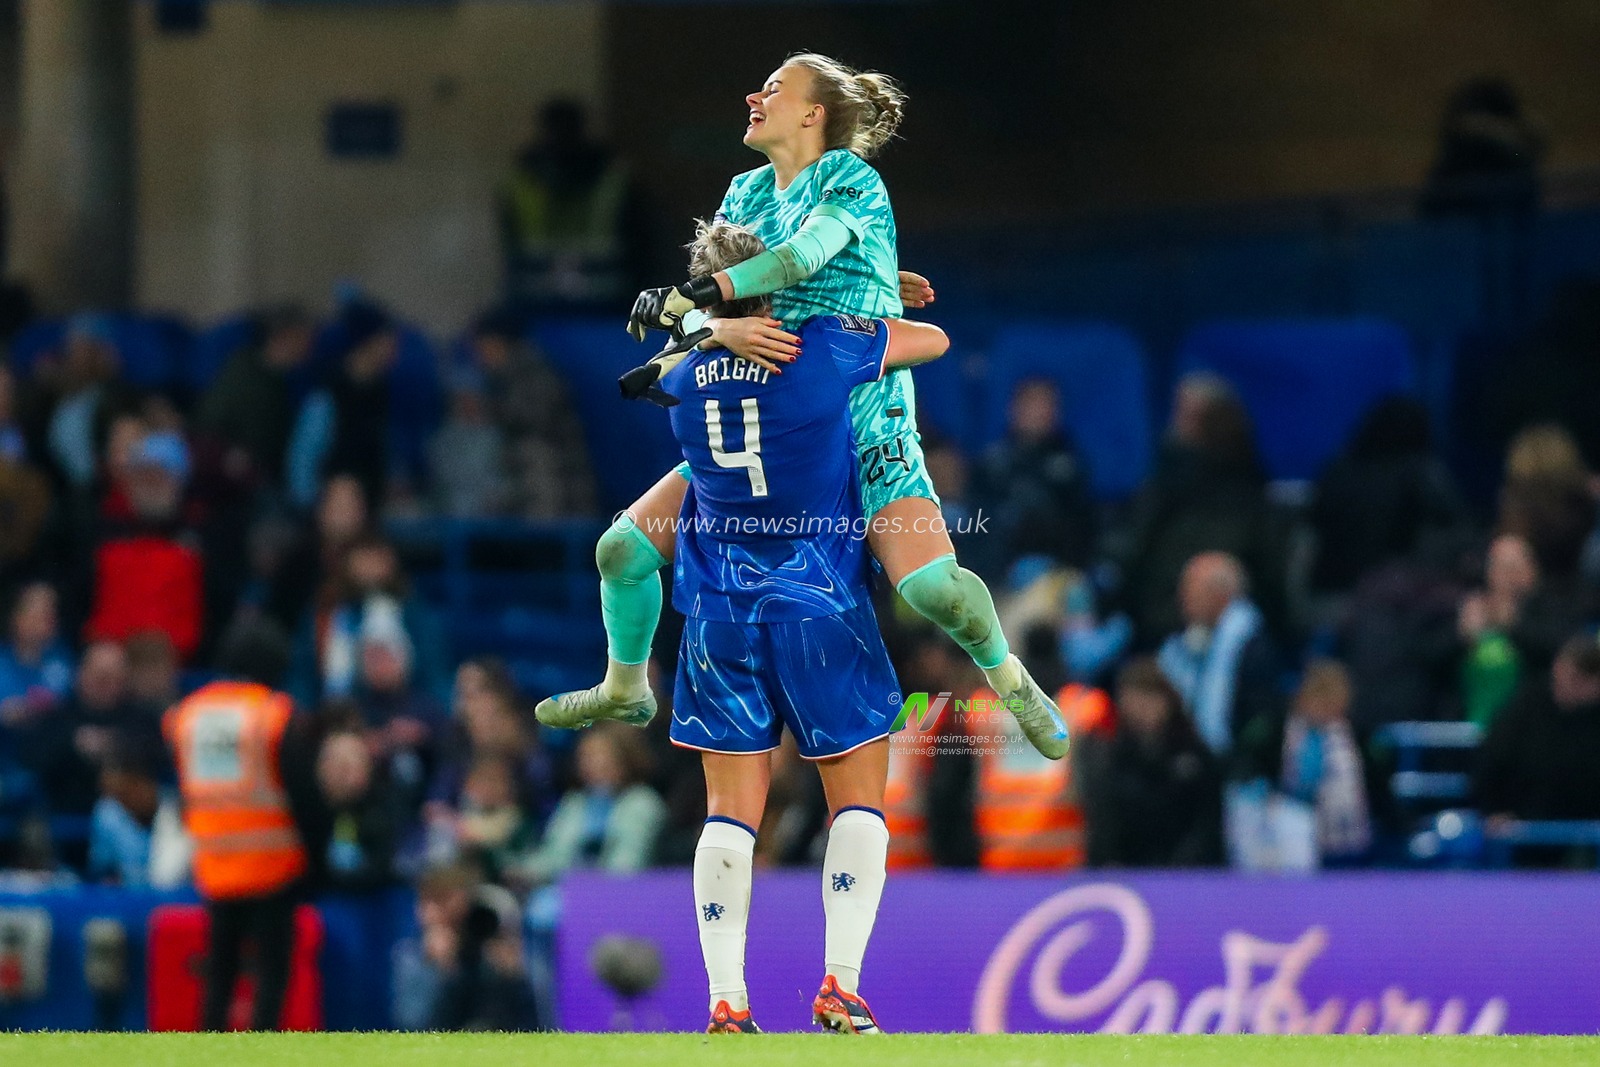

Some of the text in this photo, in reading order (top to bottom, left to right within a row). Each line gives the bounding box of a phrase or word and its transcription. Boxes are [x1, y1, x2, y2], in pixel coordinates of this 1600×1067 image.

[820, 186, 863, 201] ever
[705, 398, 768, 496] 4
[861, 437, 910, 486] 24
